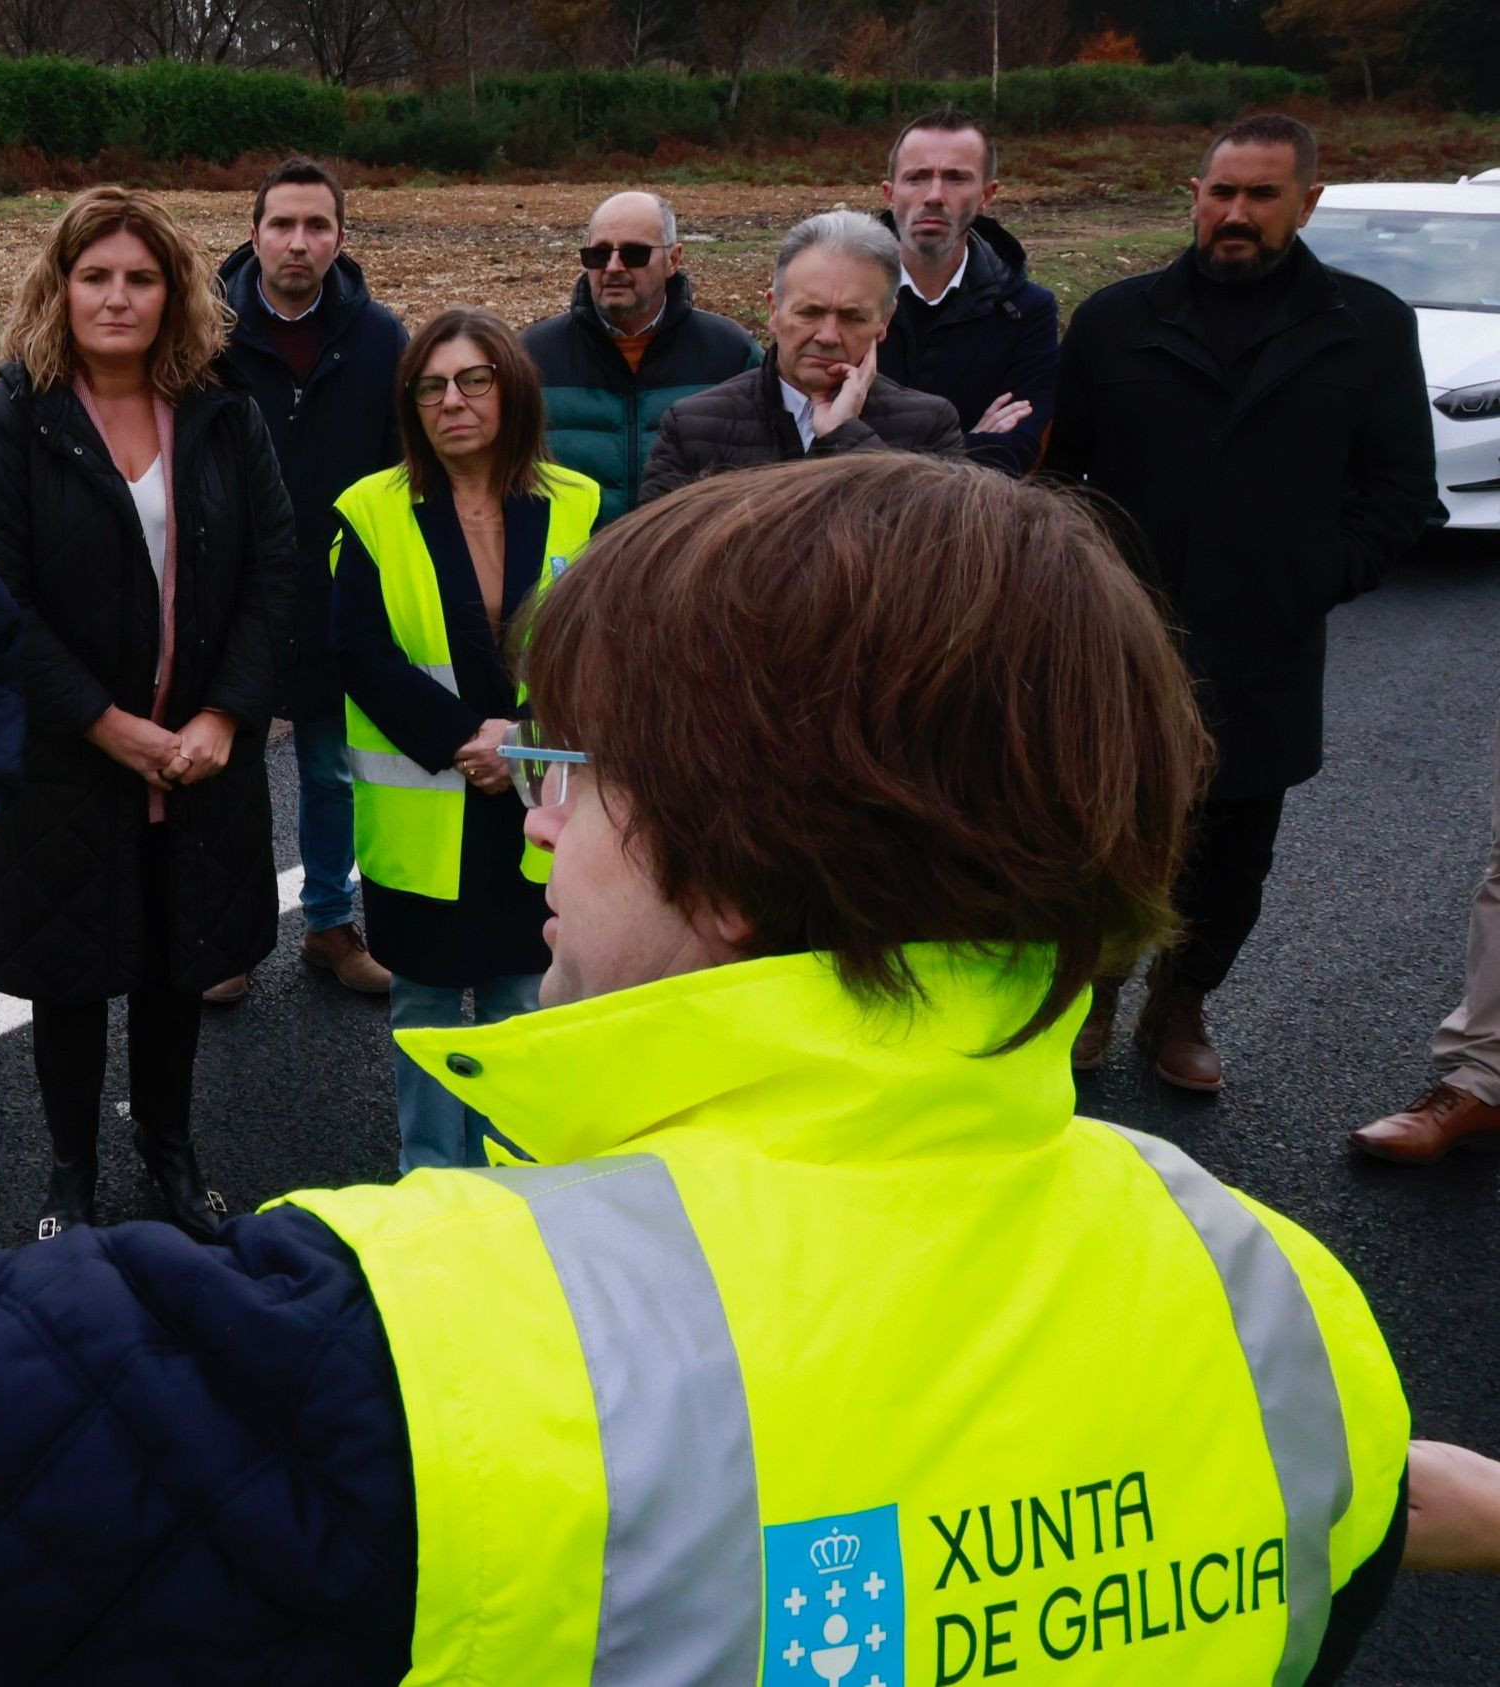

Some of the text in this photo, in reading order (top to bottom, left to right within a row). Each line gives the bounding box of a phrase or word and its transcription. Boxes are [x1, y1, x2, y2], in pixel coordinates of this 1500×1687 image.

[928, 1470, 1154, 1590] XUNTA
[935, 1537, 1287, 1687] DE GALICIA
